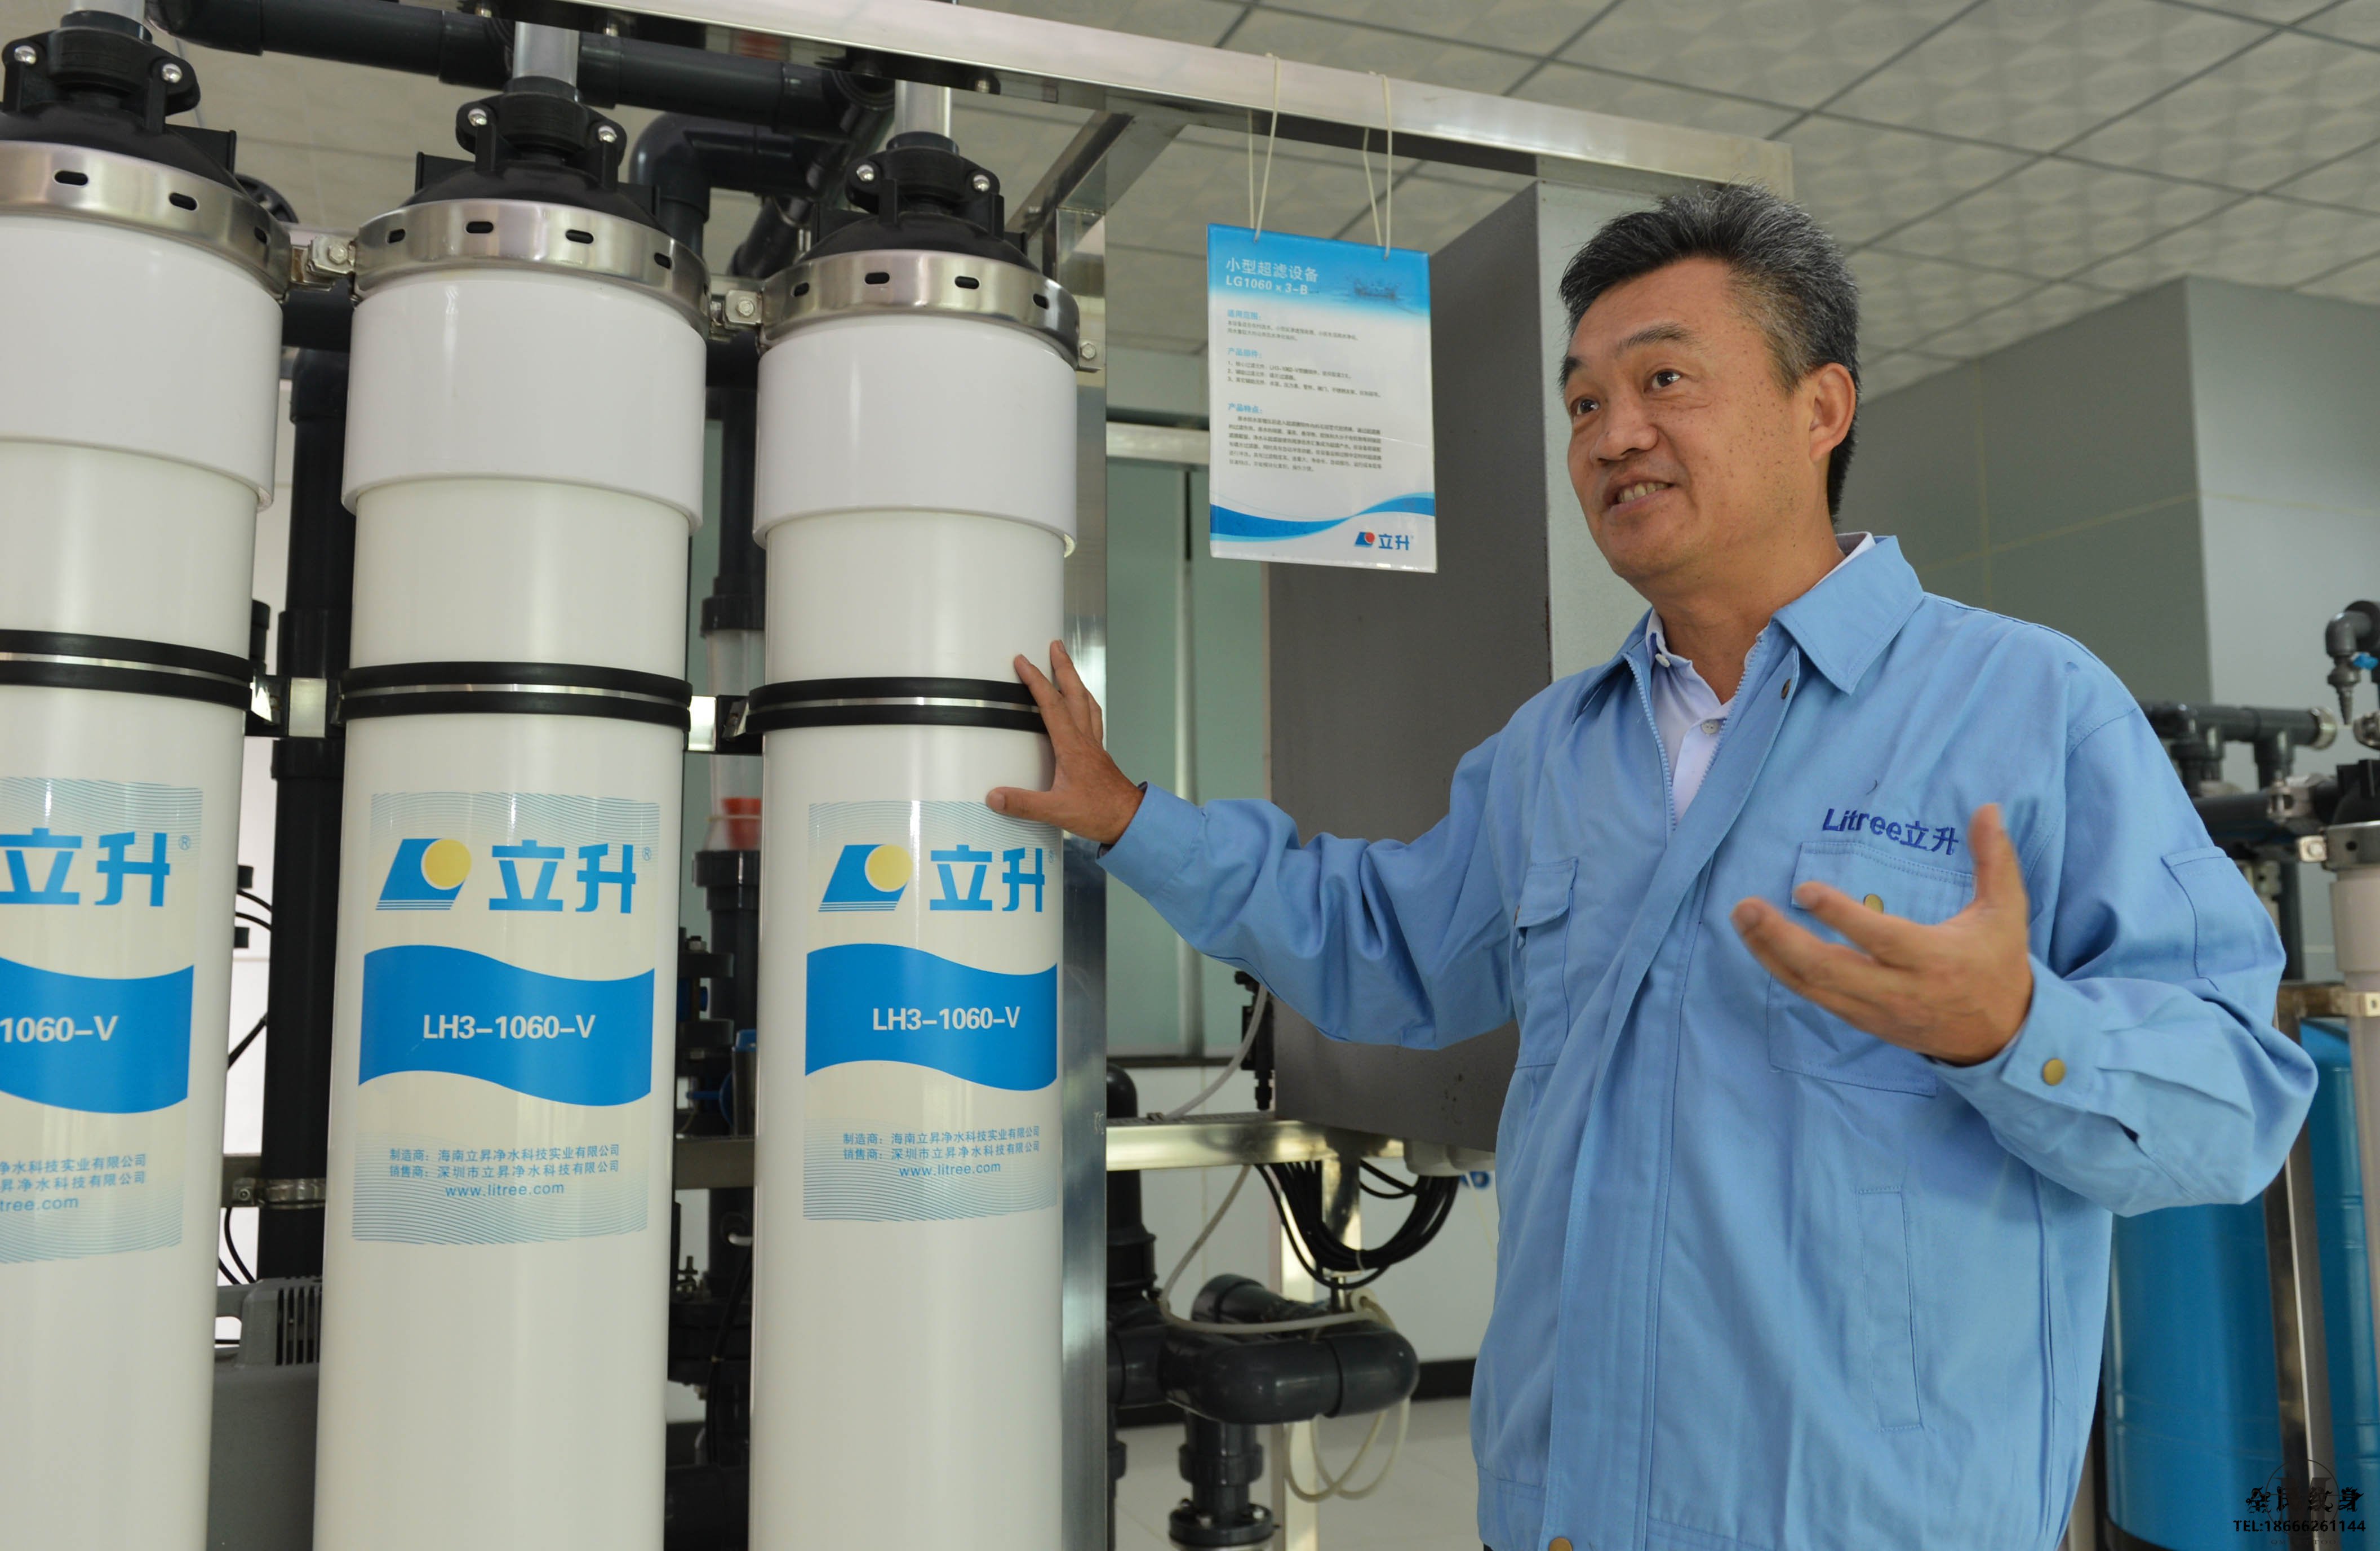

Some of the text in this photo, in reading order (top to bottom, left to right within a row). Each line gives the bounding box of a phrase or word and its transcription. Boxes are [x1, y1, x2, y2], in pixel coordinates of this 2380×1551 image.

[1226, 257, 1318, 282] 小型超滤设备
[1226, 274, 1273, 290] LG1060
[0, 1015, 119, 1043] 1060-V
[423, 1014, 596, 1039] LH3-1060-V
[873, 1006, 1020, 1030] LH3-1060-V
[899, 1162, 1001, 1177] www.litree.com
[445, 1183, 565, 1198] www.litree.com
